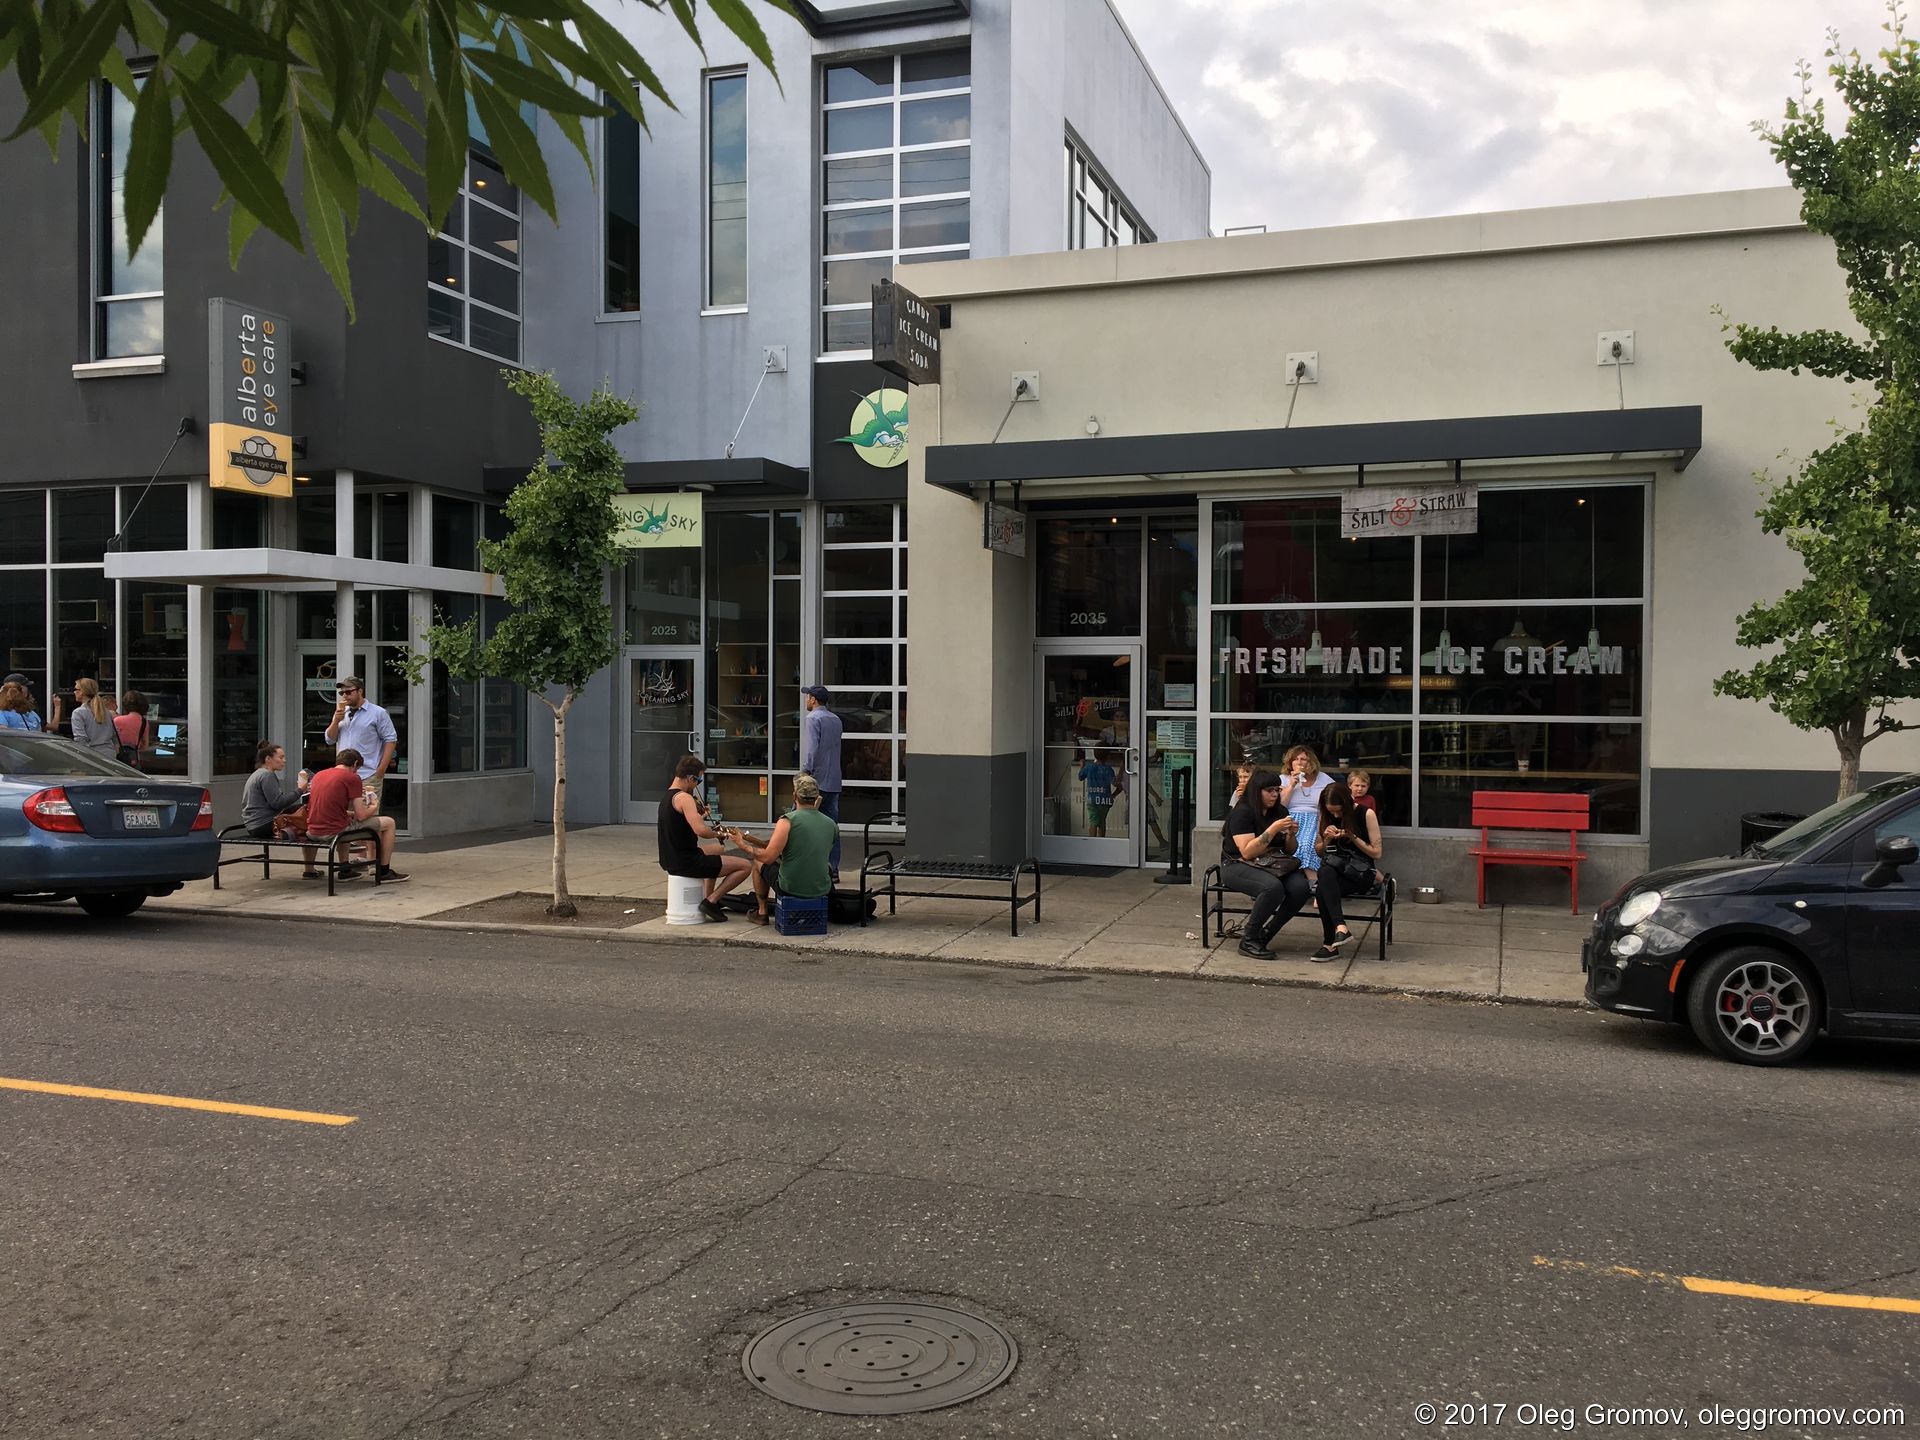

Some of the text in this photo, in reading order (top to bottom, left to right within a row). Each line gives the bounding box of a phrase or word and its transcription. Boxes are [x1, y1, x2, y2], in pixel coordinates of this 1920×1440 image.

[906, 299, 930, 324] CANDY
[899, 317, 938, 352] ICE CREAM
[237, 314, 257, 423] alberta
[910, 348, 929, 370] SODA
[262, 320, 278, 427] eye care
[258, 460, 271, 470] eye
[1351, 491, 1467, 530] SALT & STRAW
[669, 514, 698, 533] SKY
[325, 618, 337, 629] 20
[1070, 612, 1106, 625] 2035
[651, 625, 678, 636] 2025
[1219, 646, 1623, 675] FRESH MADE ICE CREAM
[1055, 705, 1076, 718] SALT
[1094, 697, 1120, 712] STRAW
